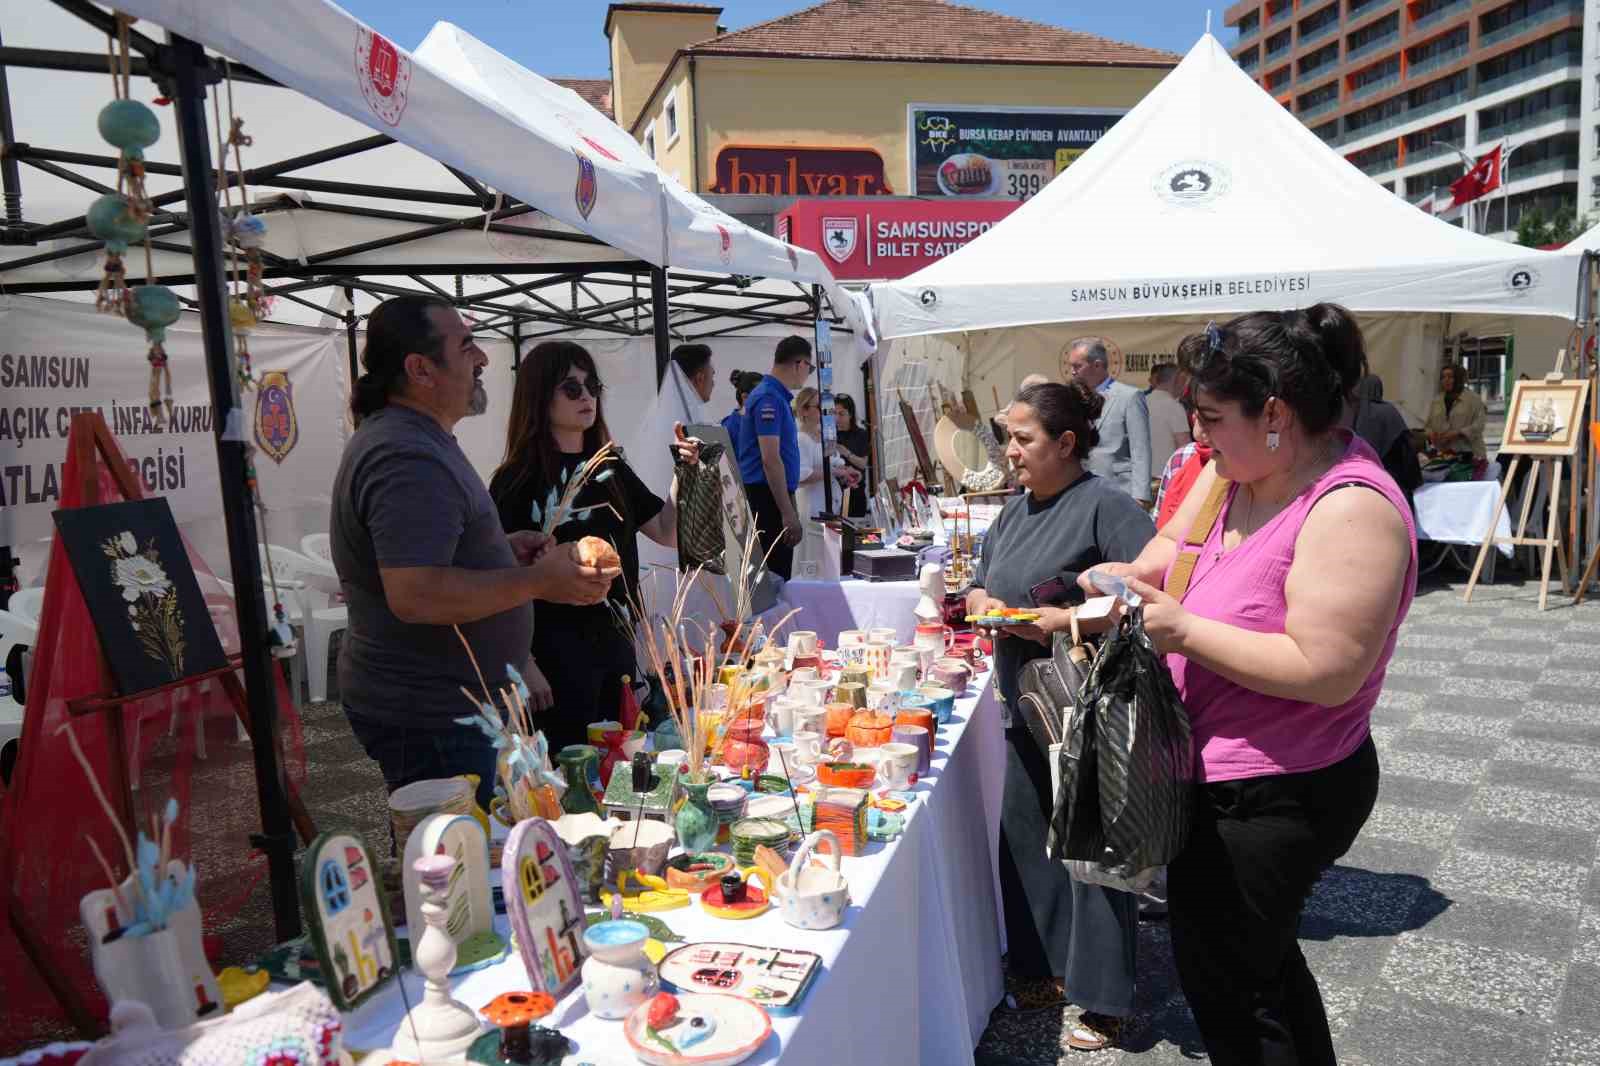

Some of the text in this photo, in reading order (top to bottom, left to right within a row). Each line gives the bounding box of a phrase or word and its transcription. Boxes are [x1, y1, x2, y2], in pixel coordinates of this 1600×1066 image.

[959, 128, 987, 141] BURSA
[987, 129, 1014, 142] KEBAP
[728, 157, 876, 195] bulvar
[1007, 174, 1040, 196] 399
[877, 221, 999, 239] SAMSUNSPO
[1071, 273, 1311, 302] SAMSUN BÜYÜKŞEHİR BELEDİYESİ
[1, 354, 90, 389] SAMSUN
[0, 406, 51, 448] AÇIK
[168, 406, 216, 434] KURU
